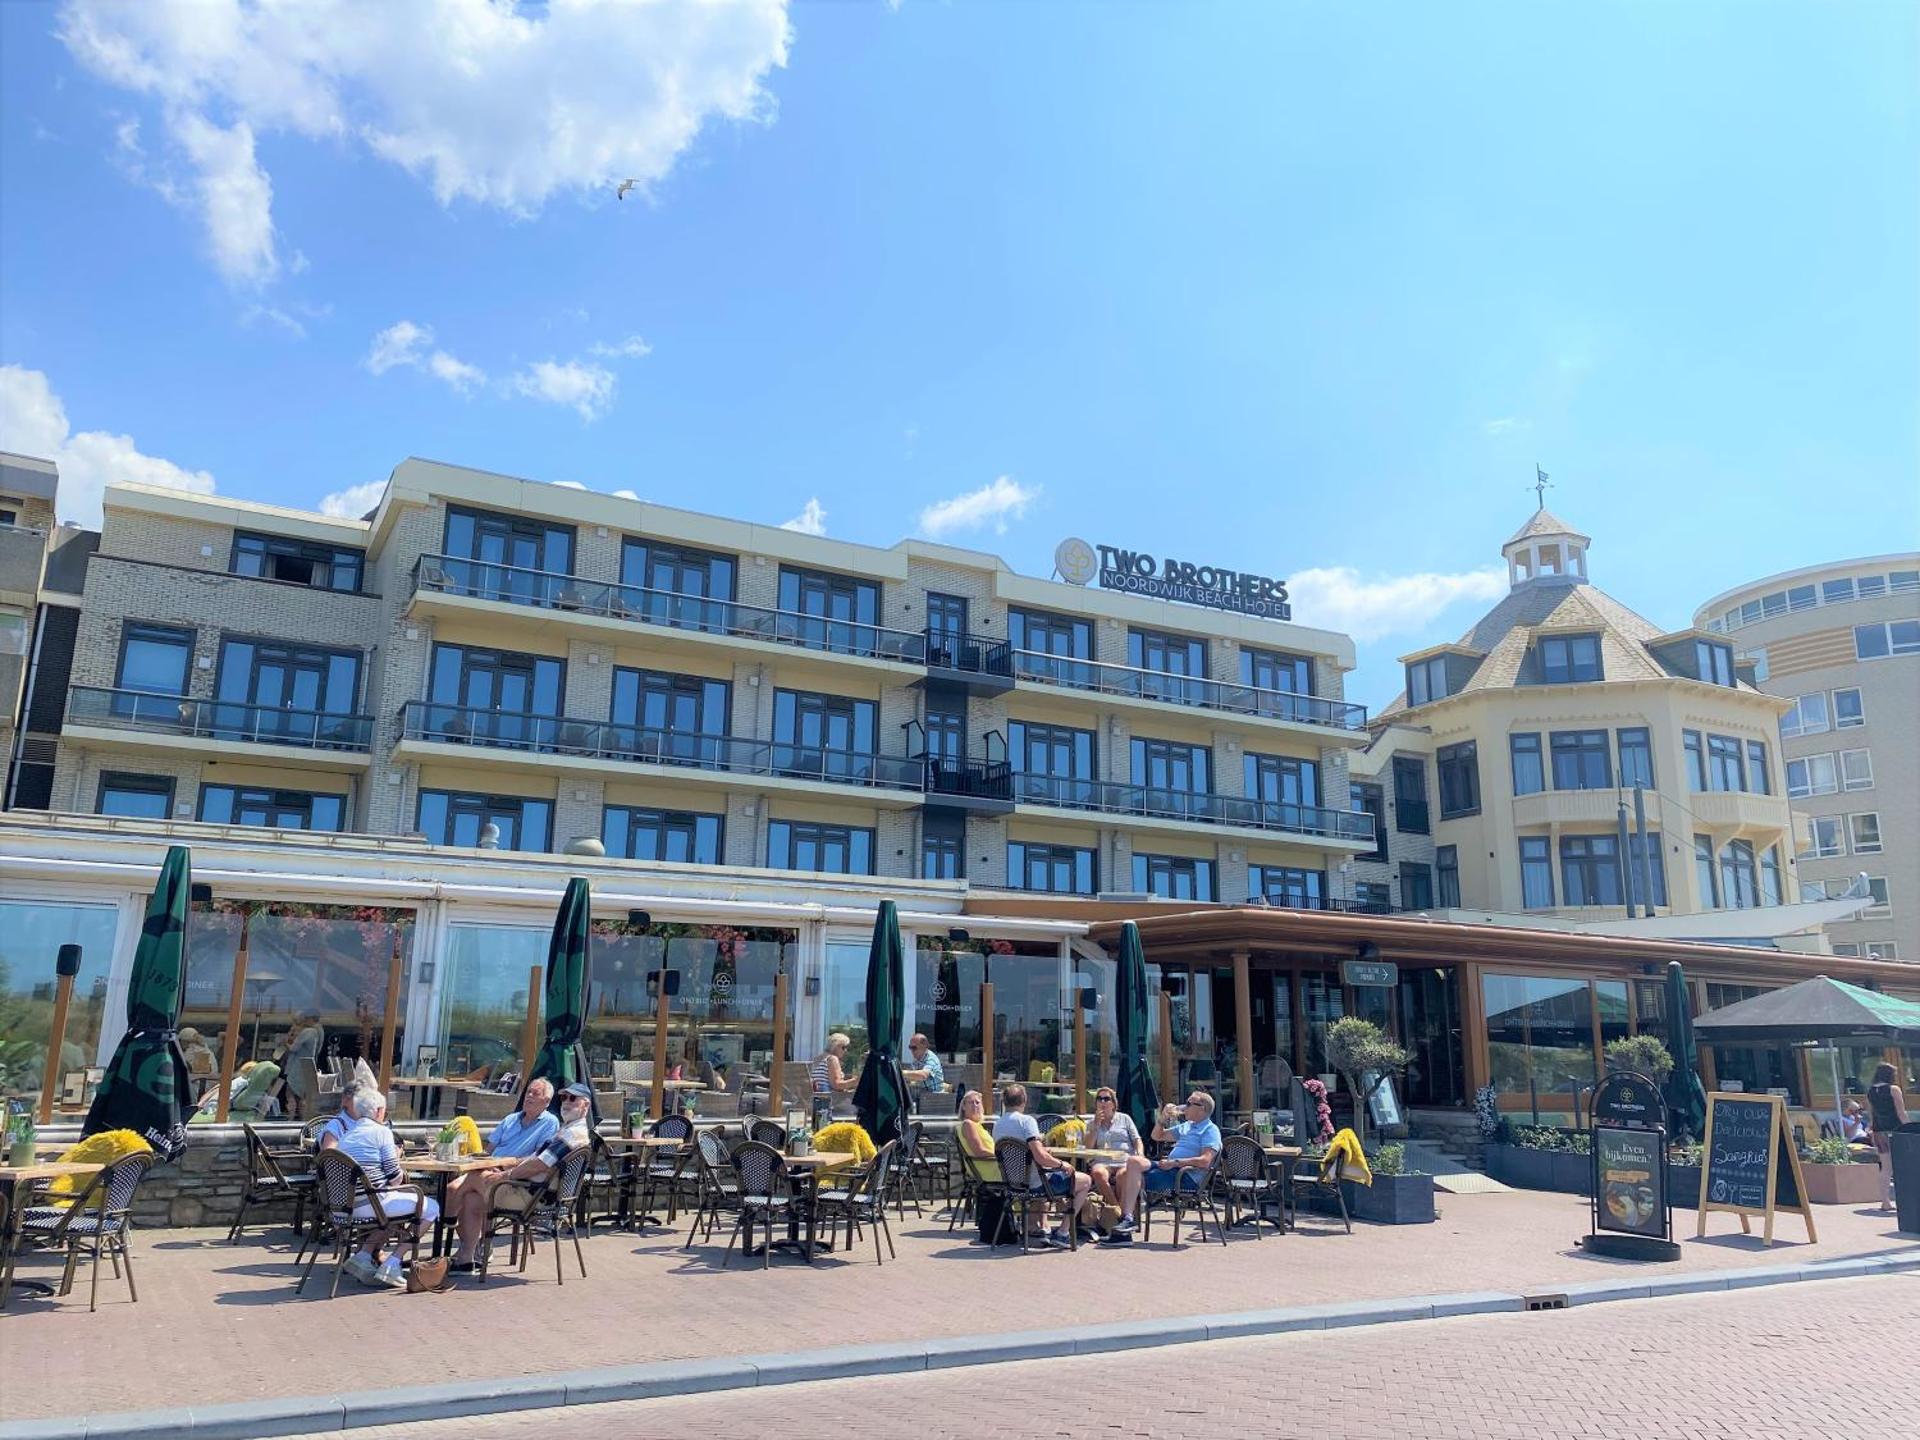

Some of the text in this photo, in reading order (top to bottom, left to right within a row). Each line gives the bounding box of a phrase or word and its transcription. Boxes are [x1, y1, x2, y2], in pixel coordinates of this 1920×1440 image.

[1096, 544, 1289, 603] TWO BROTHERS
[1103, 571, 1289, 618] NOORDWIJK BEACH HOTEL
[144, 1126, 174, 1152] Hein
[1622, 1143, 1645, 1154] Even
